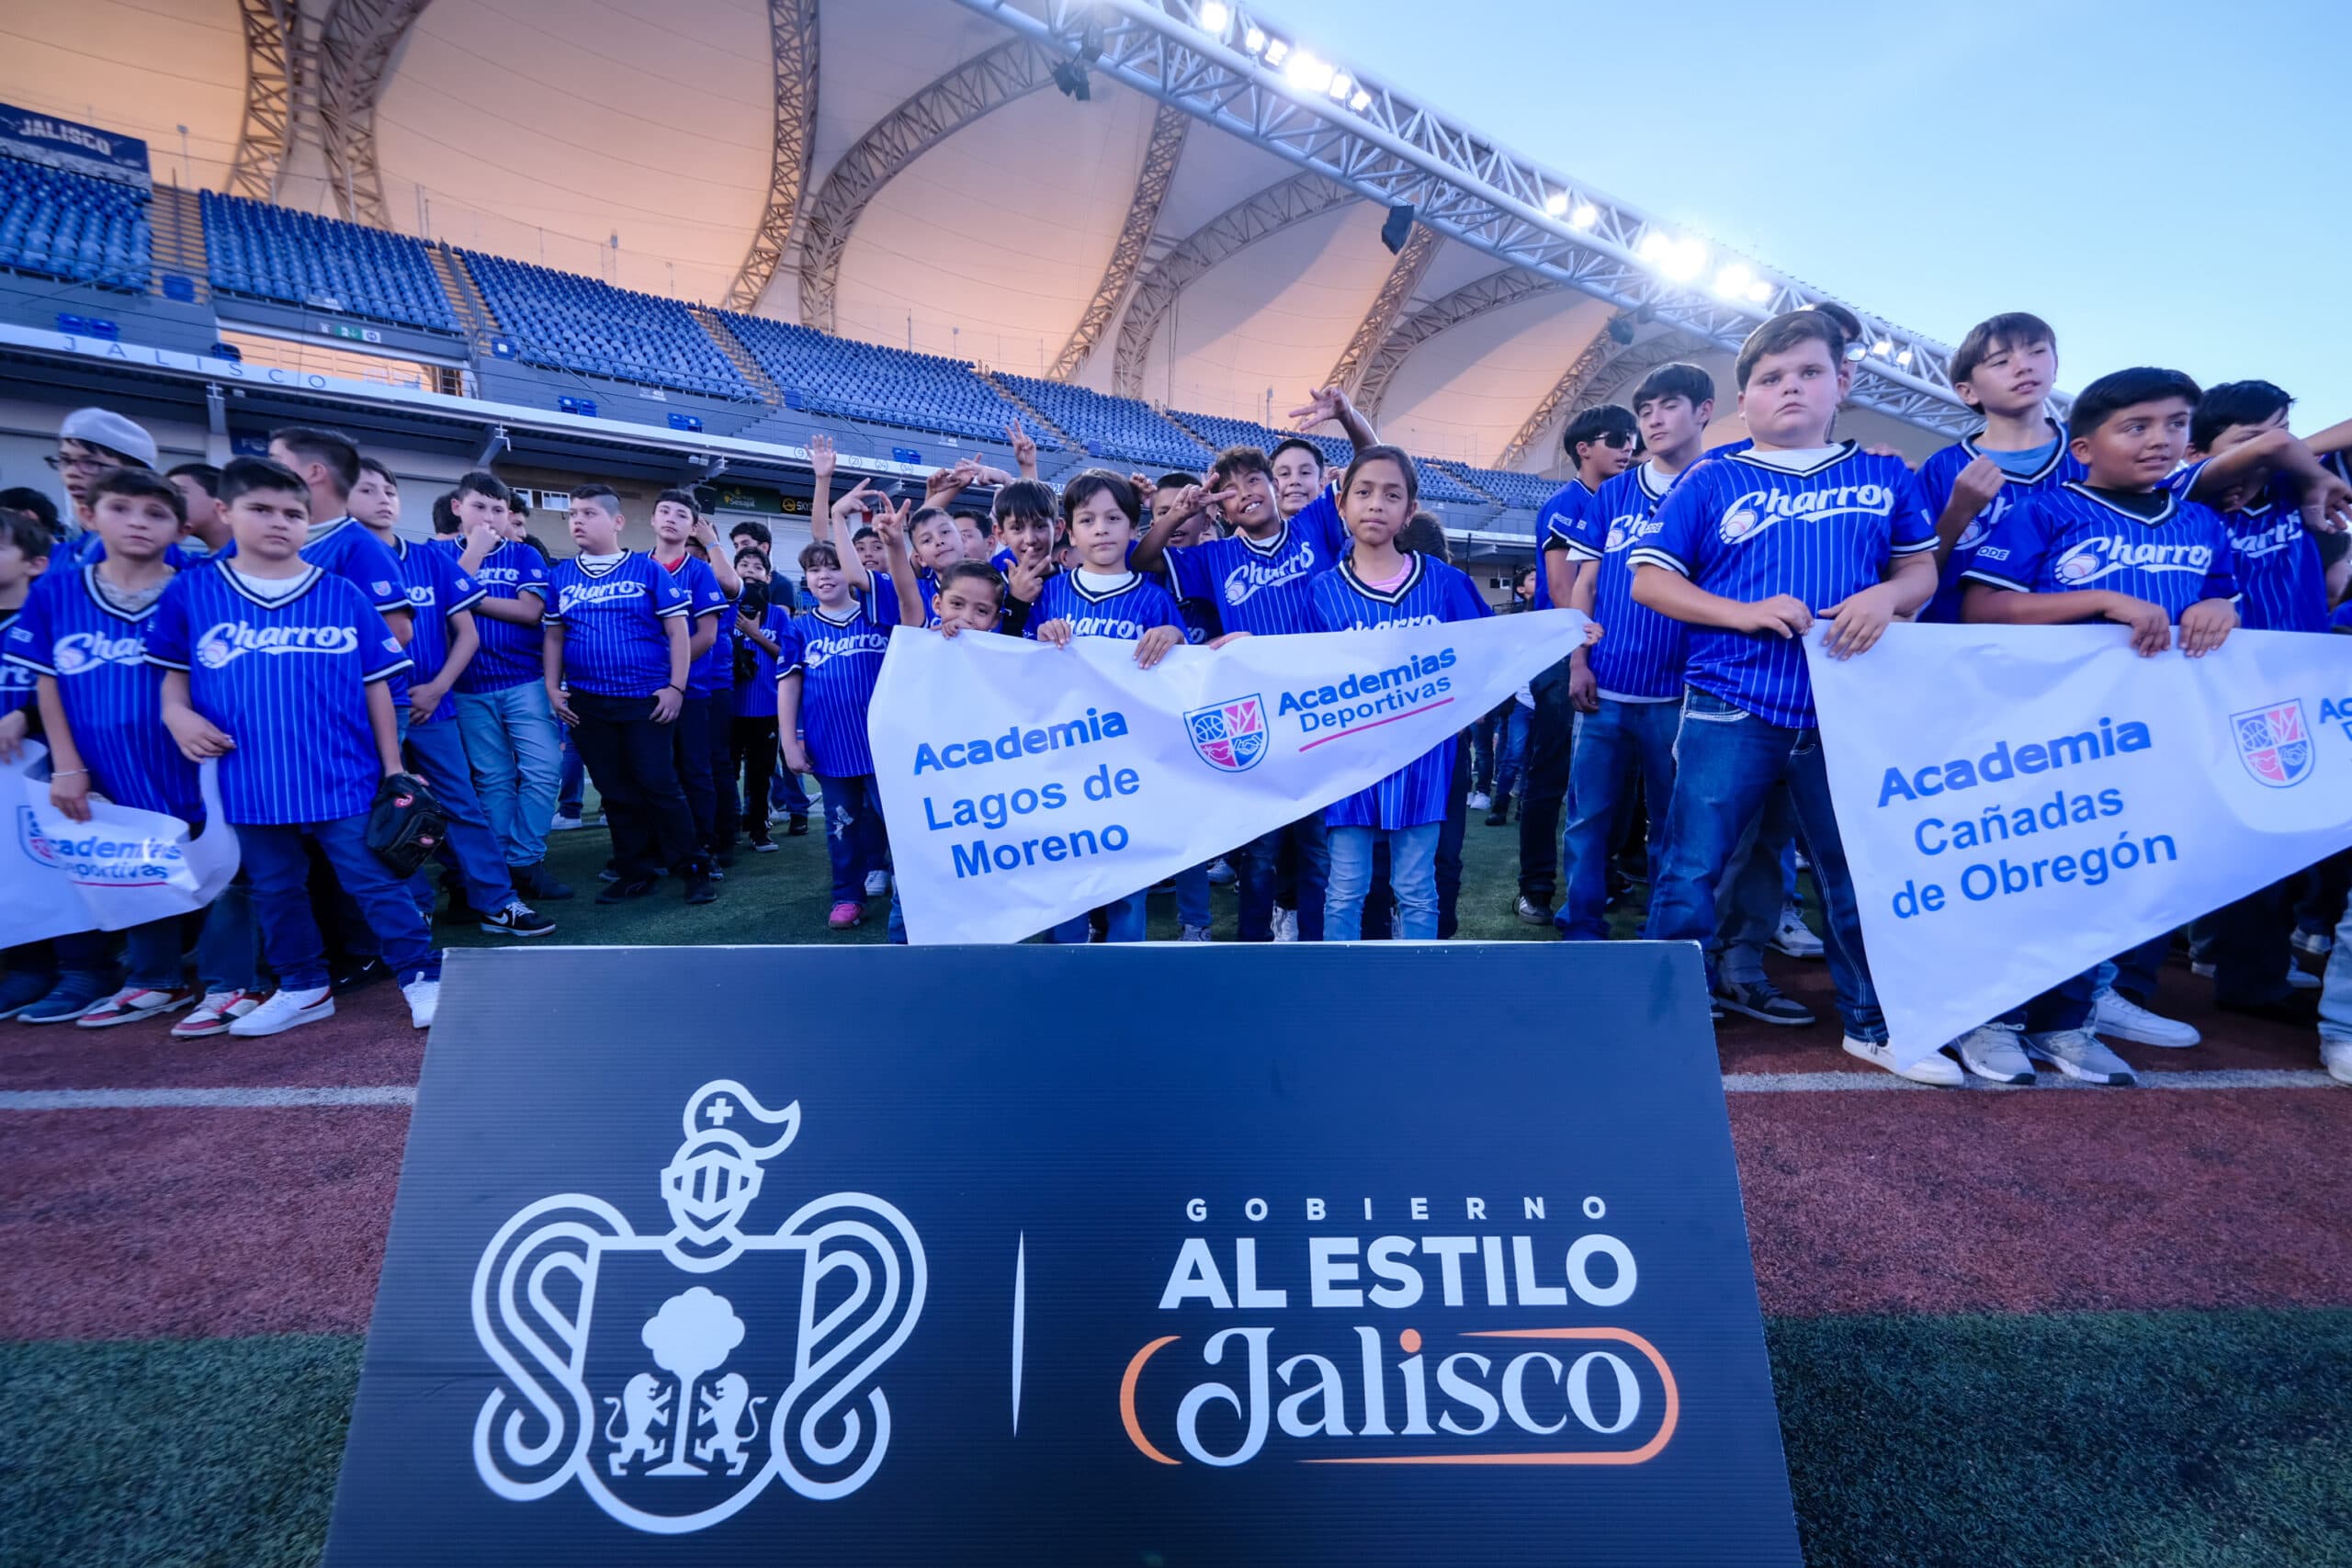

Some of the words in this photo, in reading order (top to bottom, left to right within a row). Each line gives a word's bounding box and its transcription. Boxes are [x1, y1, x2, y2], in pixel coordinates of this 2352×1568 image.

[18, 118, 112, 156] JALISCO
[63, 336, 326, 389] JALISCO
[1977, 547, 2010, 560] ODE
[559, 581, 646, 615] Charros
[197, 620, 358, 670] Charros
[1279, 647, 1457, 716] Academias
[1299, 676, 1452, 733] Deportivas
[914, 707, 1128, 775] Academia
[1877, 716, 2152, 808] Academia
[923, 783, 1067, 830] Lagos
[1083, 763, 1140, 802] de
[1915, 788, 2123, 855] Cañadas
[951, 824, 1129, 878] Moreno
[1892, 879, 1946, 919] de
[1961, 830, 2177, 901] Obregón
[1185, 1195, 1607, 1223] GOBIERNO
[1158, 1237, 1287, 1309] AL
[1308, 1234, 1638, 1309] ESTILO
[1176, 1325, 1641, 1467] Jalisco
